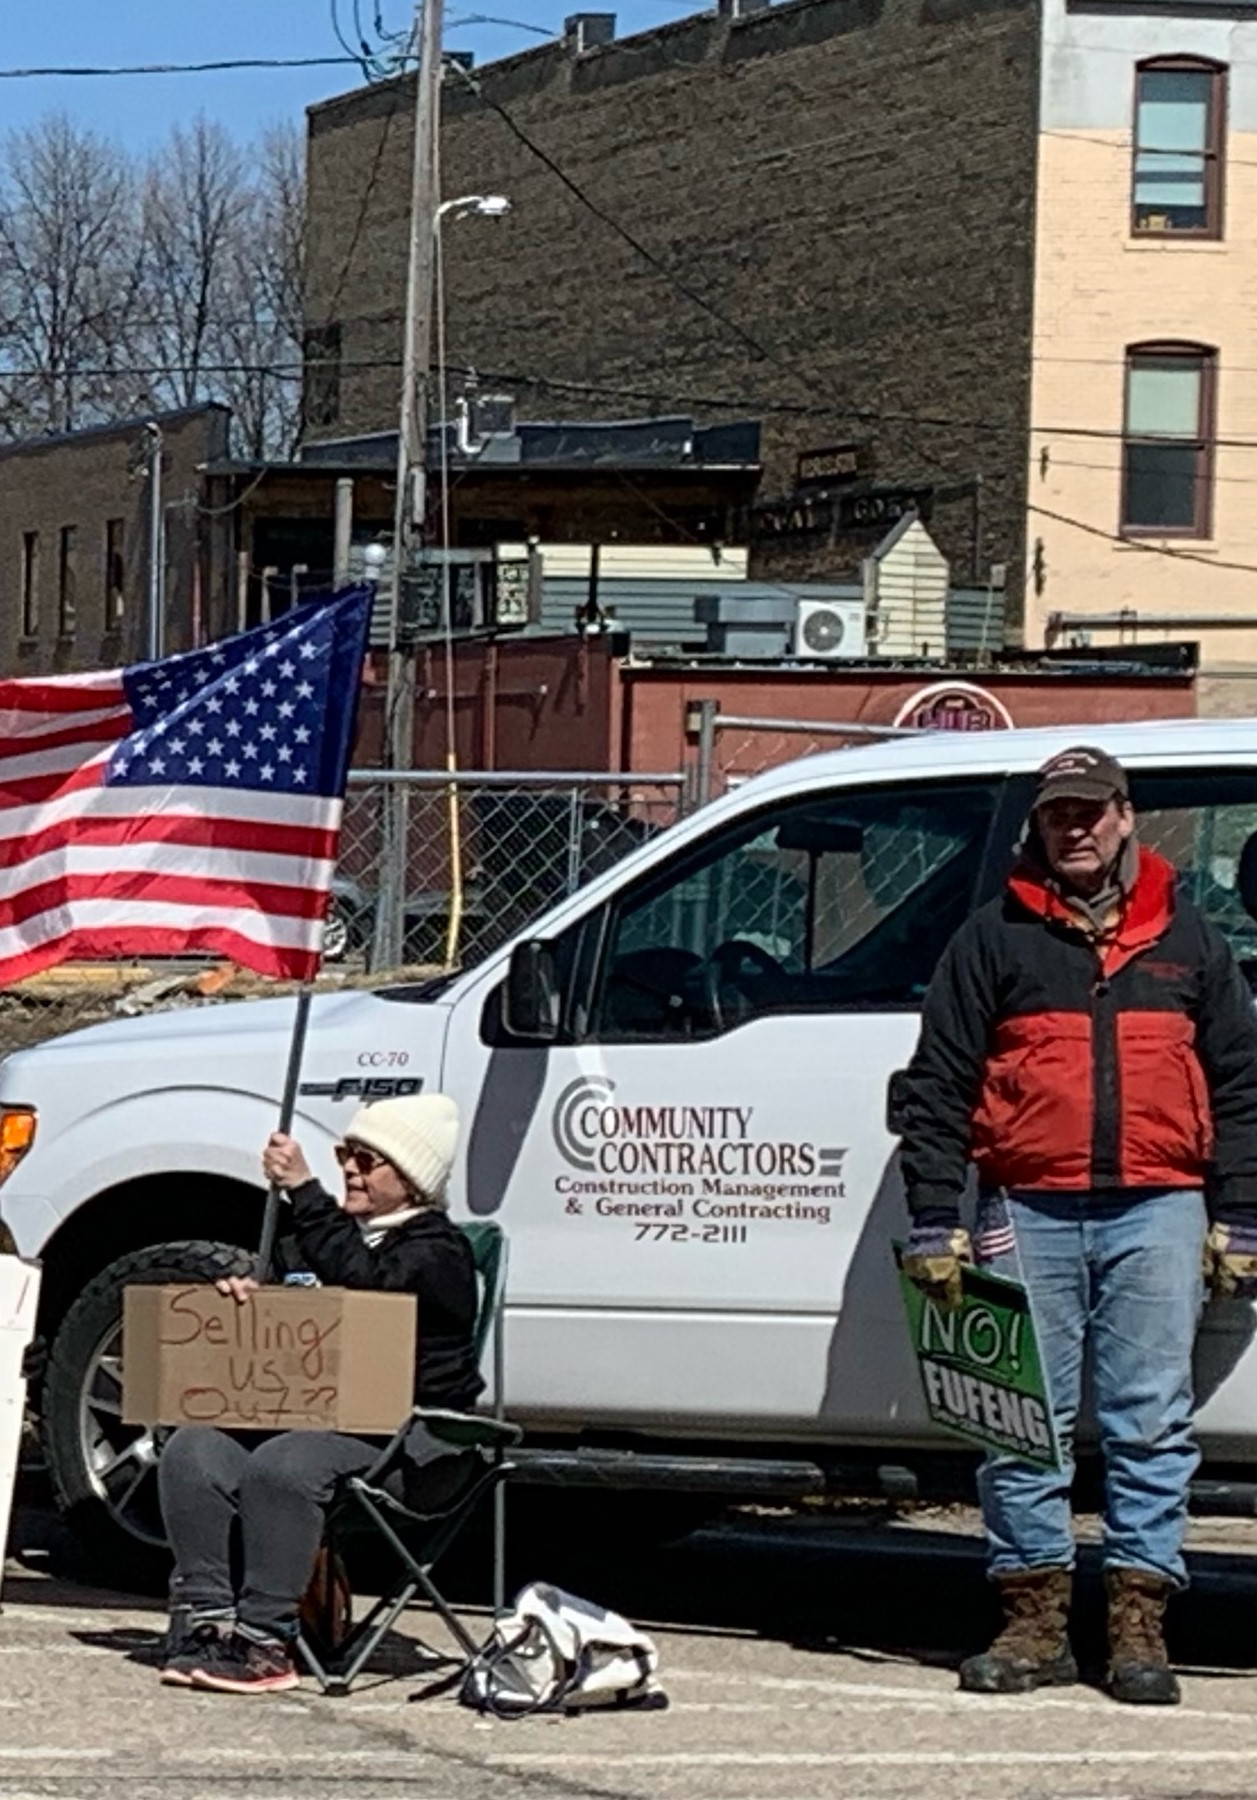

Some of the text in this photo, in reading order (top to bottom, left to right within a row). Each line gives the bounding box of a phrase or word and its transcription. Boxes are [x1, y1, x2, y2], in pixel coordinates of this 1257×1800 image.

[357, 1051, 409, 1067] CC-70
[580, 1105, 753, 1139] COMMUNITY
[598, 1141, 816, 1176] CONTRACTORS
[554, 1175, 847, 1200] Construction Management
[564, 1197, 831, 1223] & General Contracting
[634, 1222, 747, 1243] 772-2111
[158, 1286, 342, 1381] Selling
[921, 1300, 1022, 1371] NO!
[921, 1358, 1050, 1449] FUFENG
